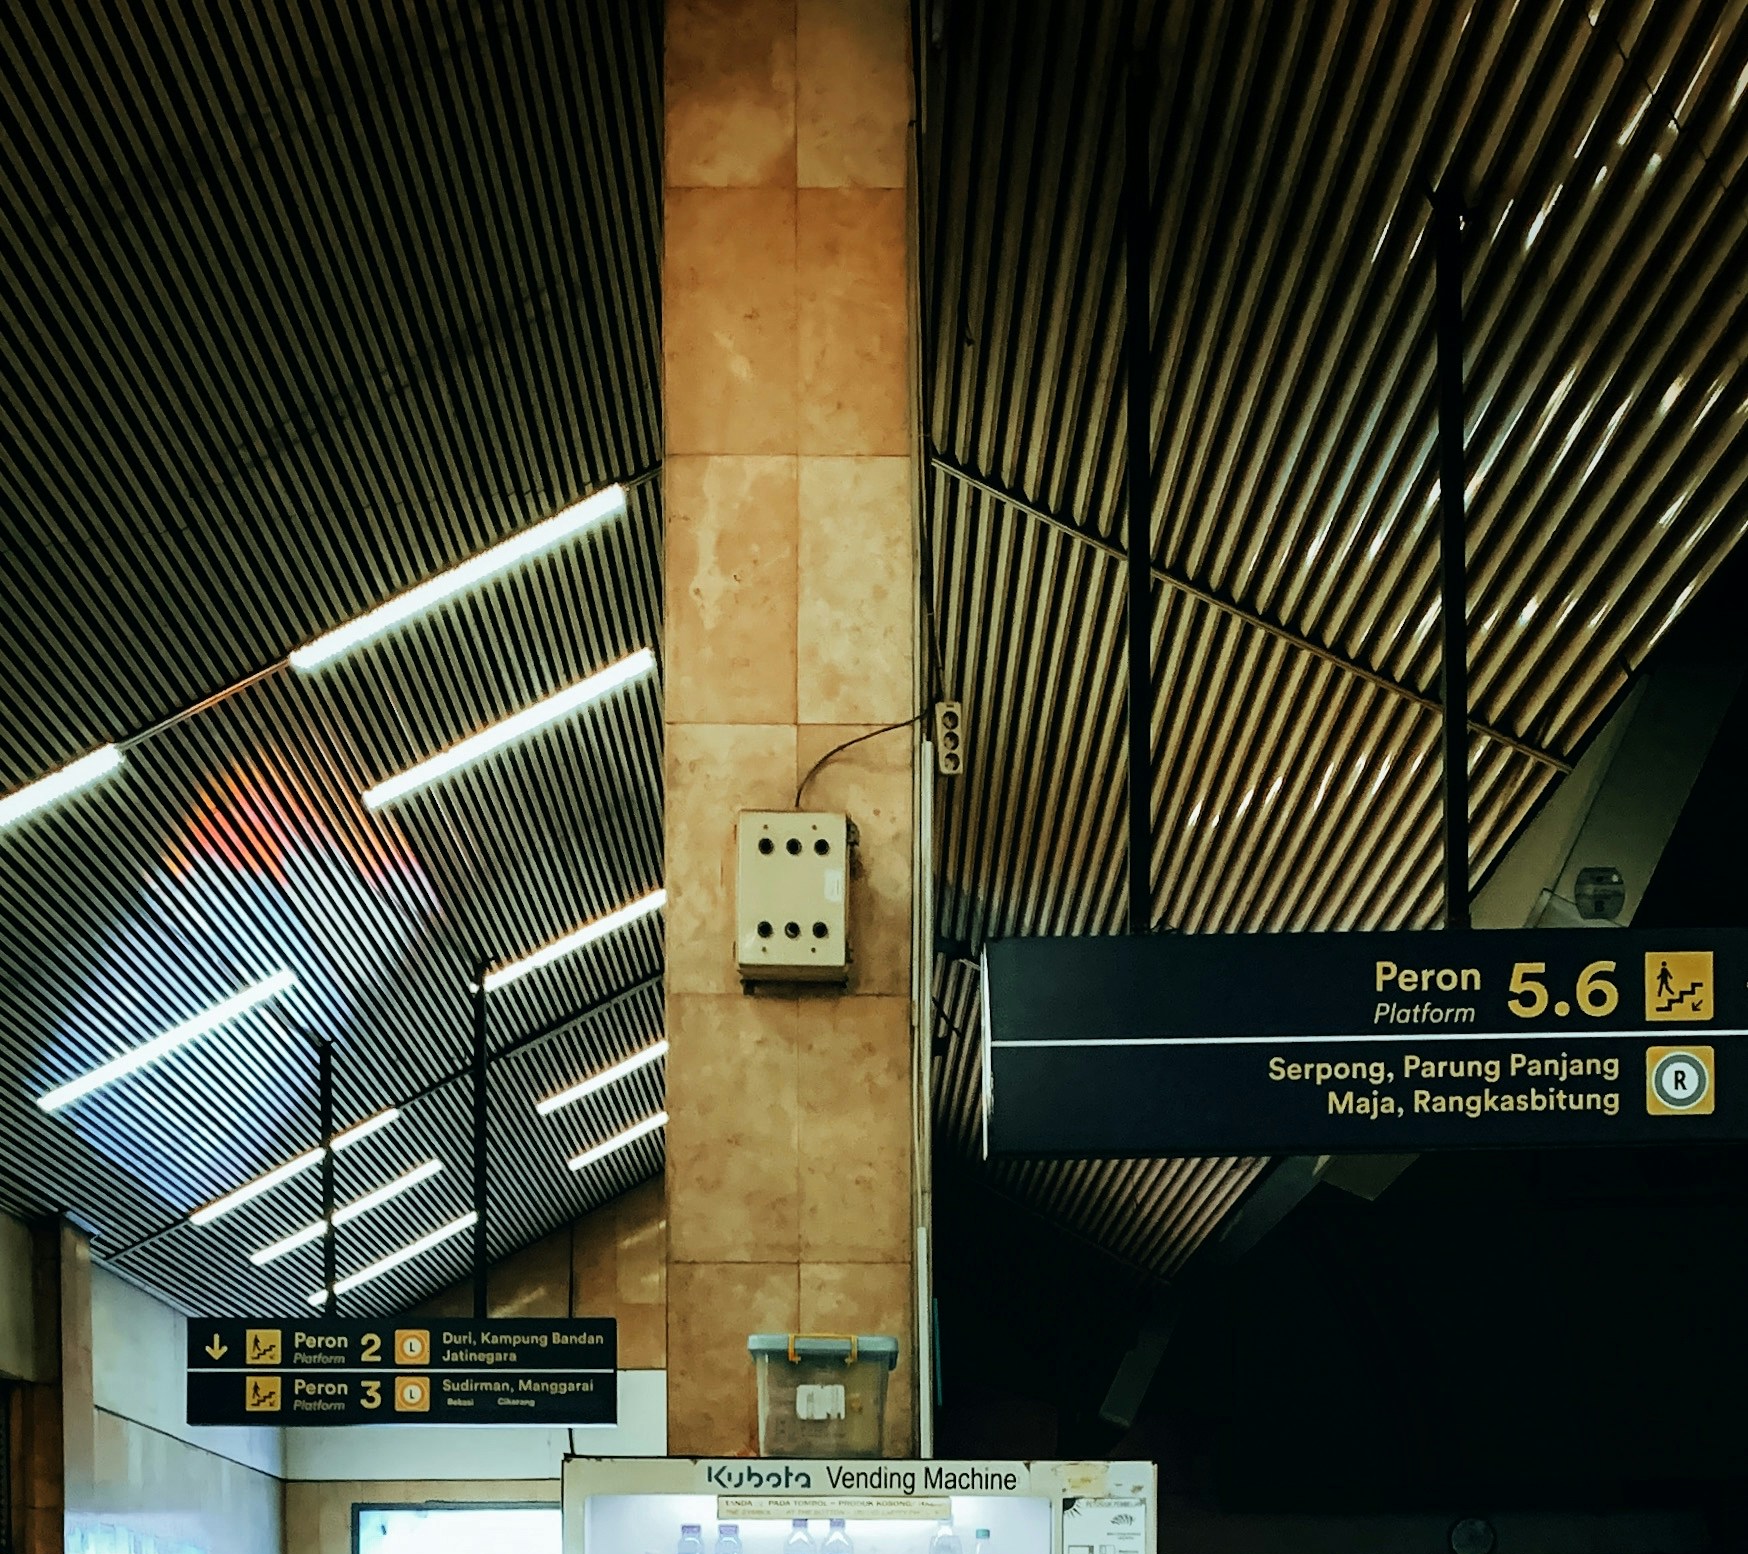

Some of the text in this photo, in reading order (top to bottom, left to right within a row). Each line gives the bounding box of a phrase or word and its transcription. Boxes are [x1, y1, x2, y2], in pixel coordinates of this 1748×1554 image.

[1375, 959, 1620, 1018] Peron 5.6
[1374, 1001, 1476, 1025] Platform
[1268, 1052, 1620, 1085] Serpong, Parung Panjang
[1674, 1070, 1687, 1090] R
[1327, 1088, 1620, 1119] Maja, Rangkasbitung
[294, 1332, 382, 1362] Peron 2
[409, 1342, 415, 1352] L
[442, 1331, 604, 1348] Duri, Kampung Bandan
[293, 1352, 345, 1364] Platform
[442, 1349, 517, 1365] Jatinegara
[294, 1378, 382, 1409] Peron 3
[409, 1389, 415, 1399] L
[442, 1378, 594, 1395] Sudirman, Manggarai
[293, 1399, 345, 1411] Platform
[706, 1465, 1017, 1494] Kubota Vending Machine
